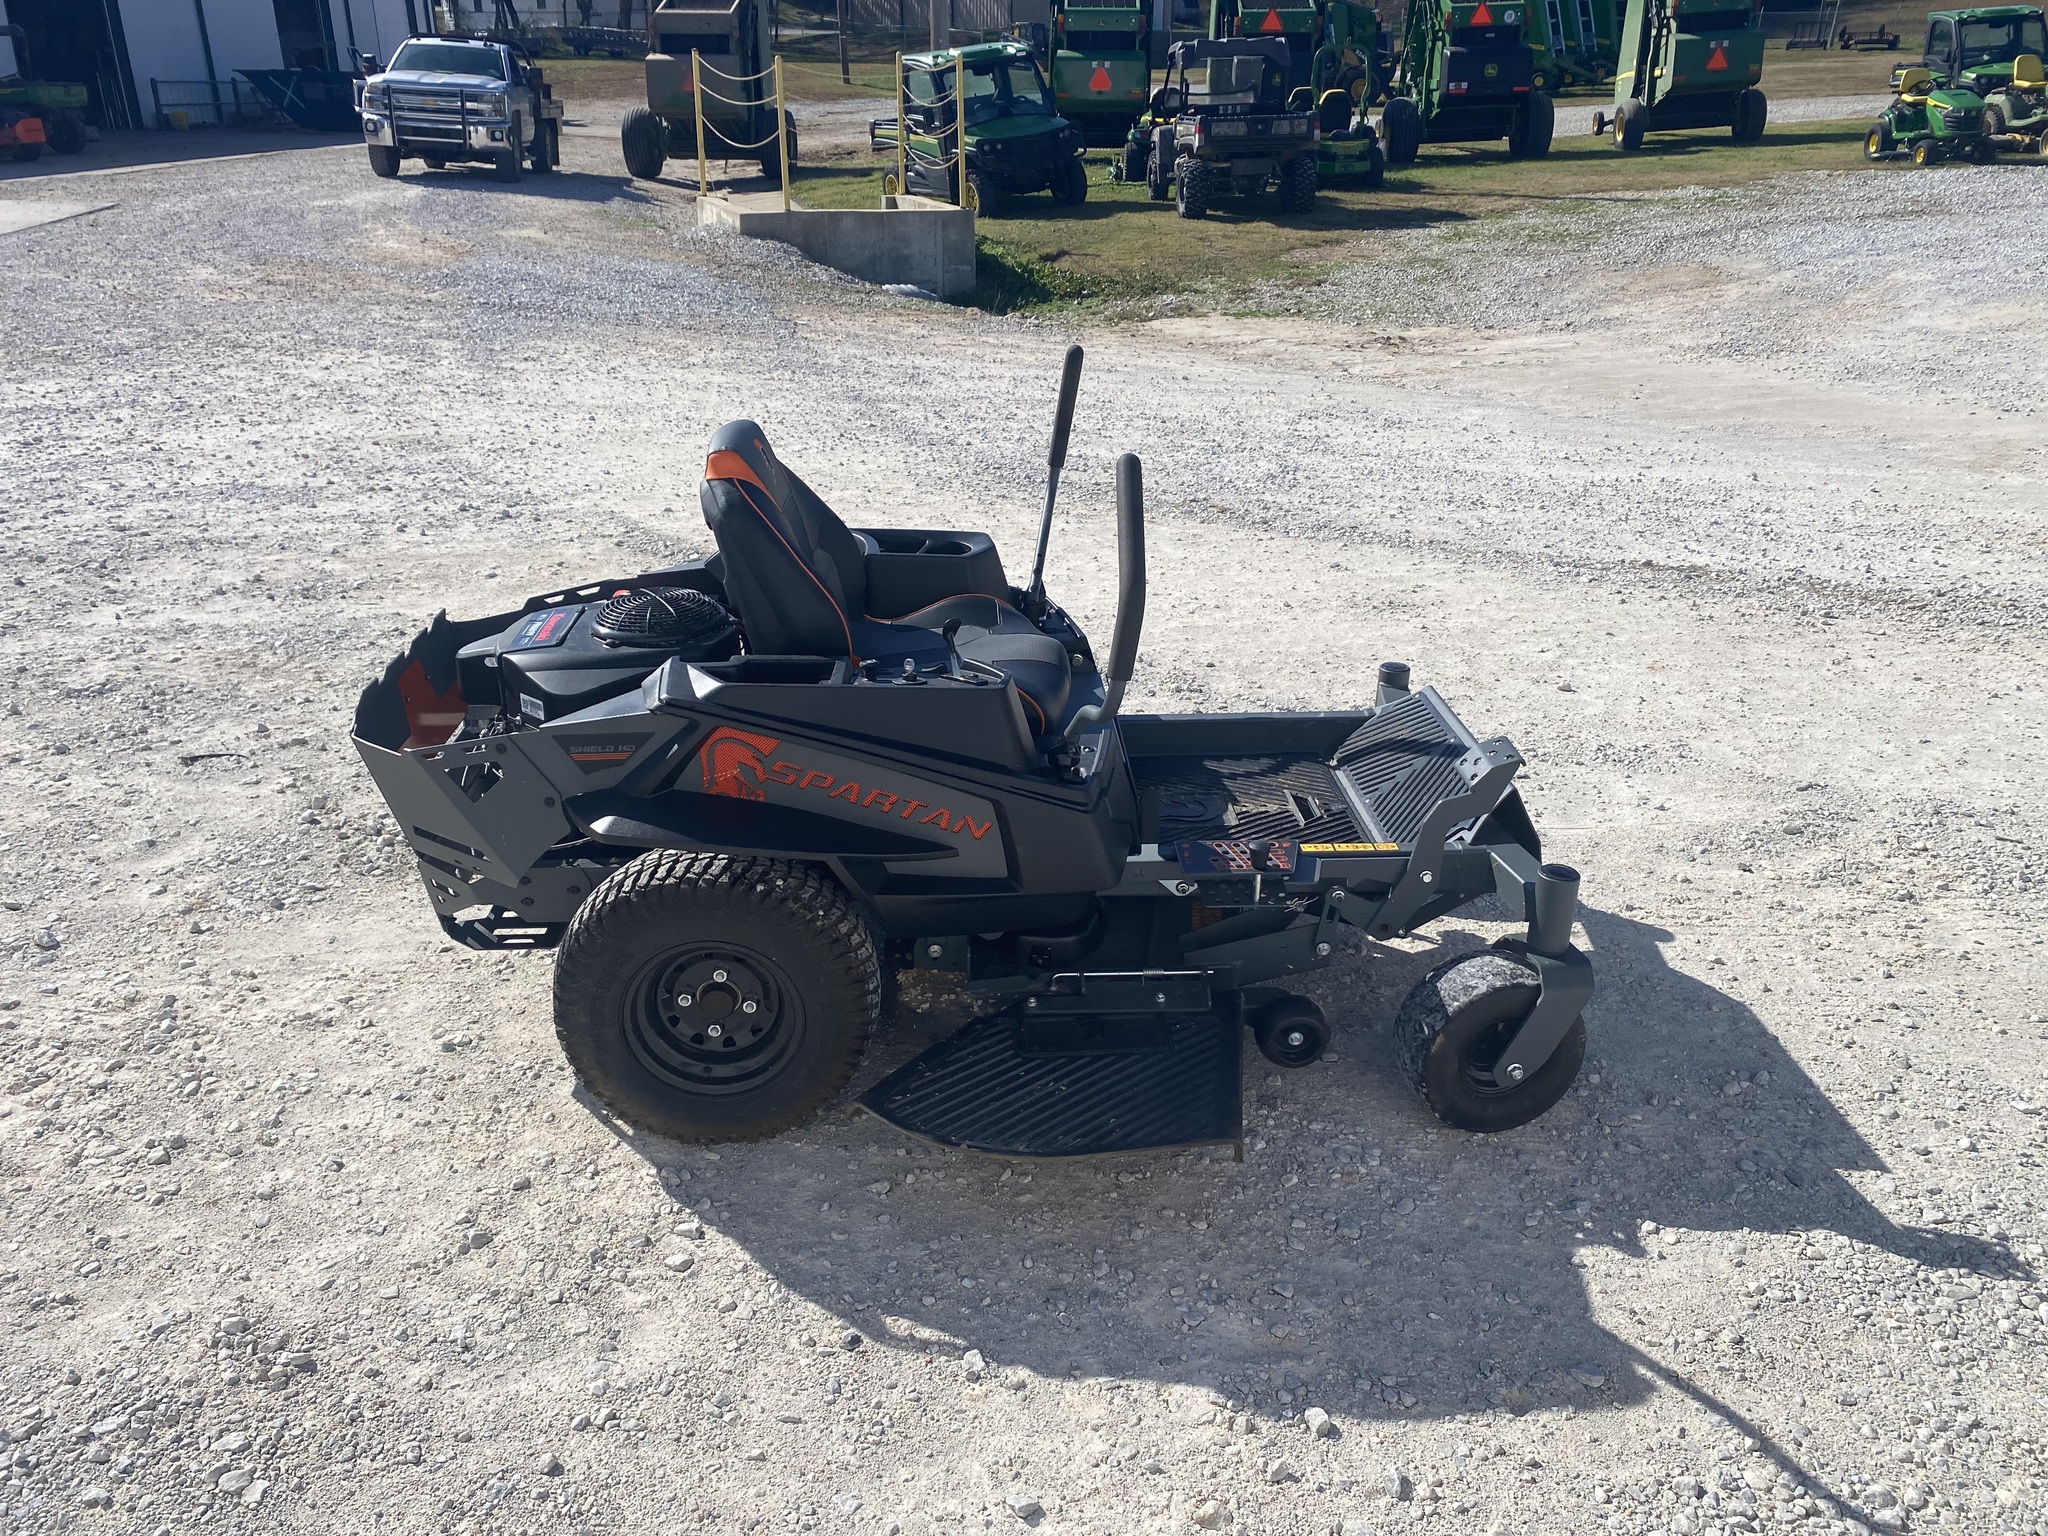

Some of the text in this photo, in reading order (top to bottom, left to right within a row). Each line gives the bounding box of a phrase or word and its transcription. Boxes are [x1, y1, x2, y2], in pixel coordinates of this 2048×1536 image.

[569, 744, 636, 753] SHIELD HD
[765, 761, 993, 840] SPARTAN
